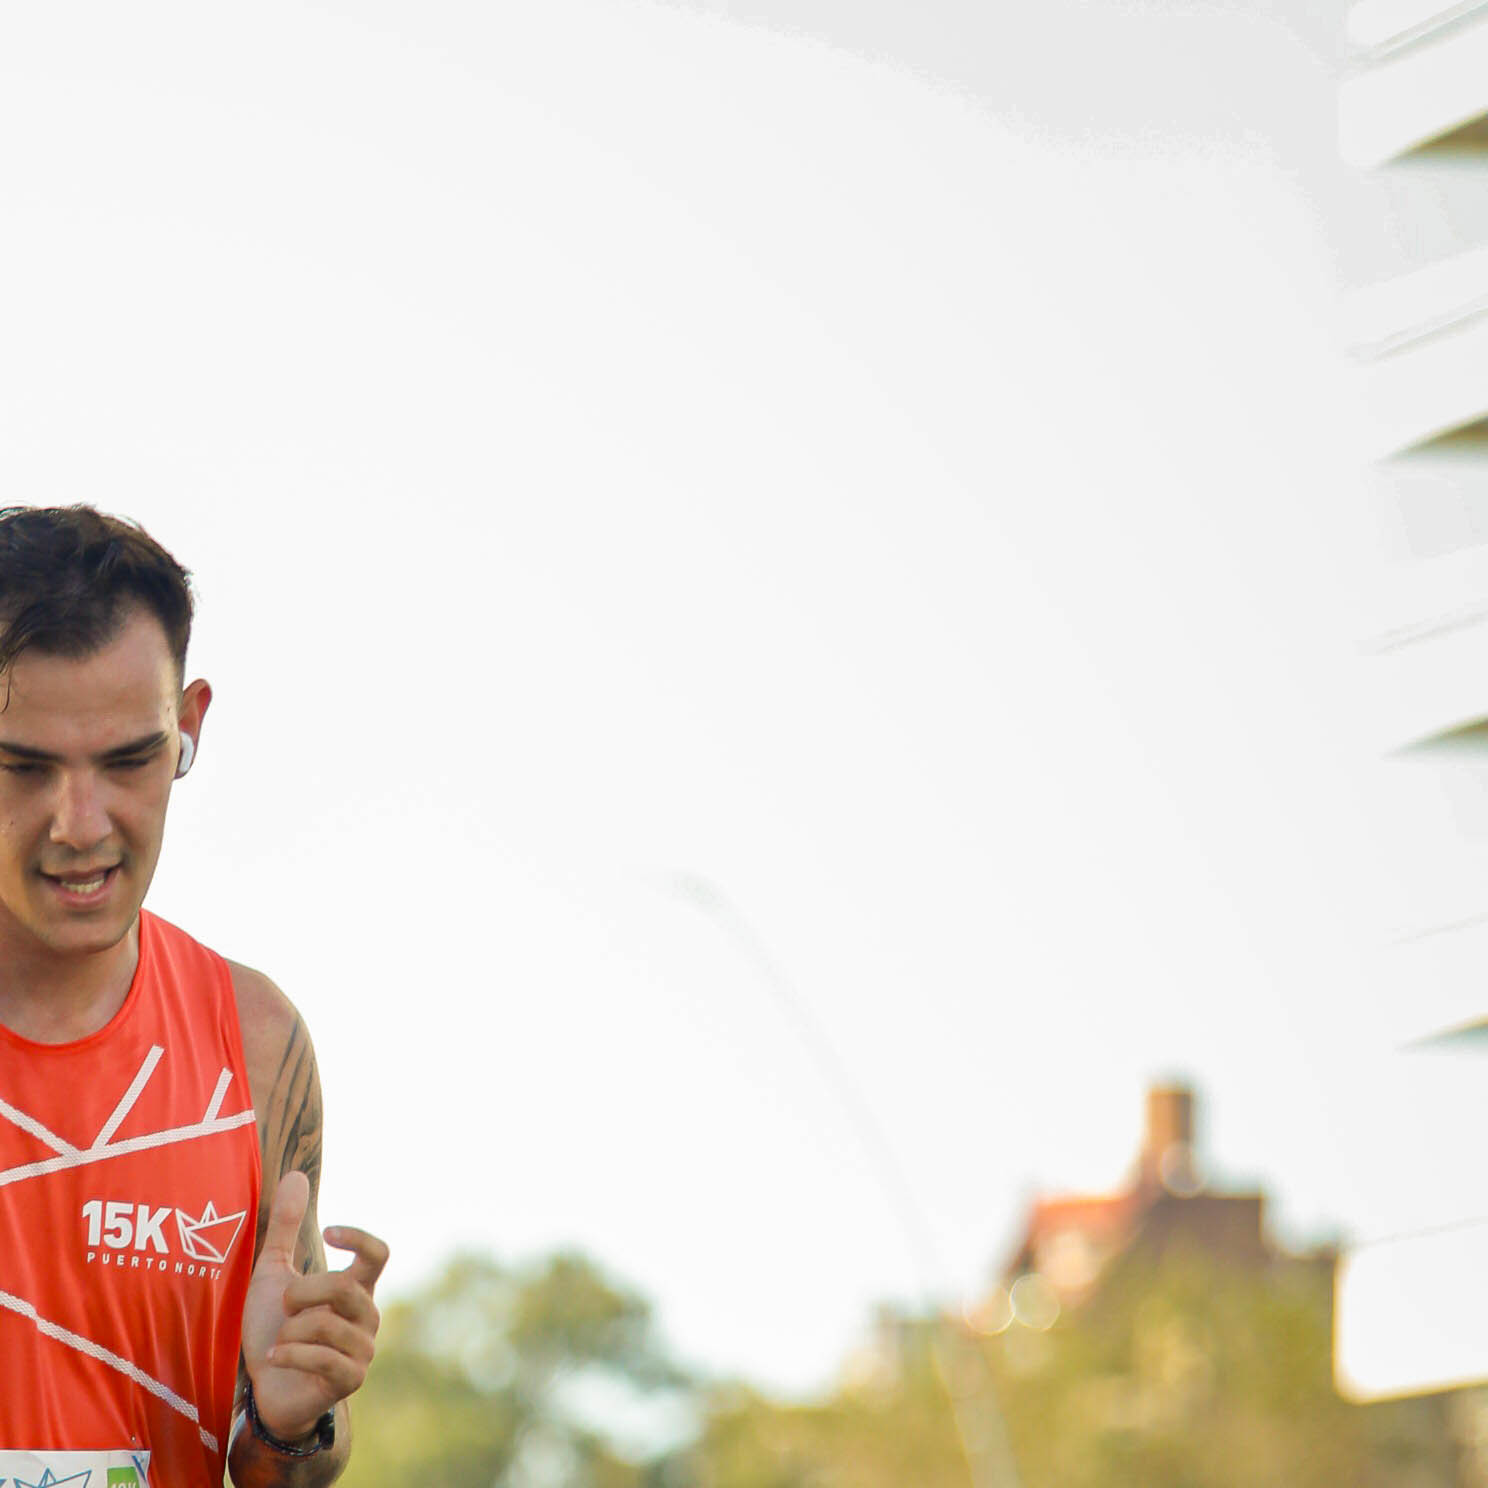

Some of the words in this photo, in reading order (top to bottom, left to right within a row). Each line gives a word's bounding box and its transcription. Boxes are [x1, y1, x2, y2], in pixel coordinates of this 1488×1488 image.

[81, 1199, 173, 1254] 15K
[86, 1252, 168, 1271] PUERTO
[174, 1262, 222, 1281] NORTE
